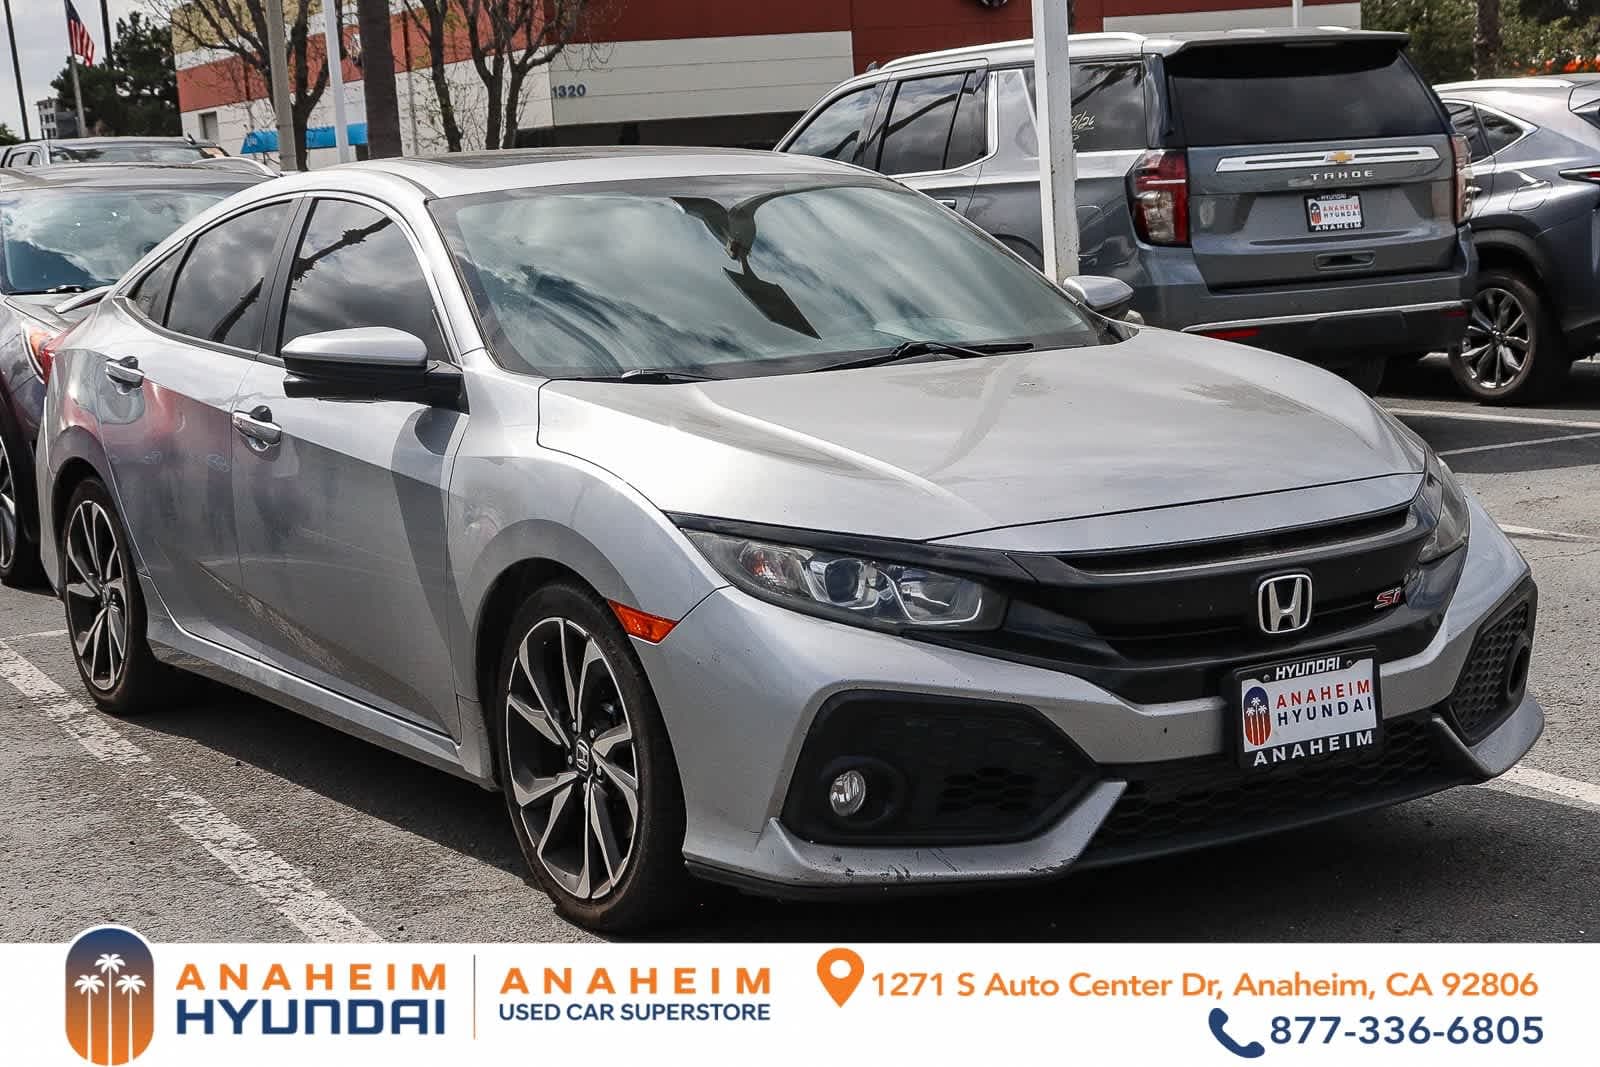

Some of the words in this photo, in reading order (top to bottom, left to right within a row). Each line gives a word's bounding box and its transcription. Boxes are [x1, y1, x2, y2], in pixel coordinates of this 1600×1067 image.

[552, 84, 587, 97] 1320
[1310, 170, 1373, 180] TAHOE
[1323, 210, 1360, 218] HYUNDAI
[1315, 222, 1361, 231] ANAHEIM
[1374, 586, 1402, 609] Si
[1275, 656, 1341, 681] HYUNDAI
[1276, 679, 1371, 710] ANAHEIM
[1277, 696, 1373, 727] HYUNDAI
[1253, 730, 1373, 767] ANAHEIM
